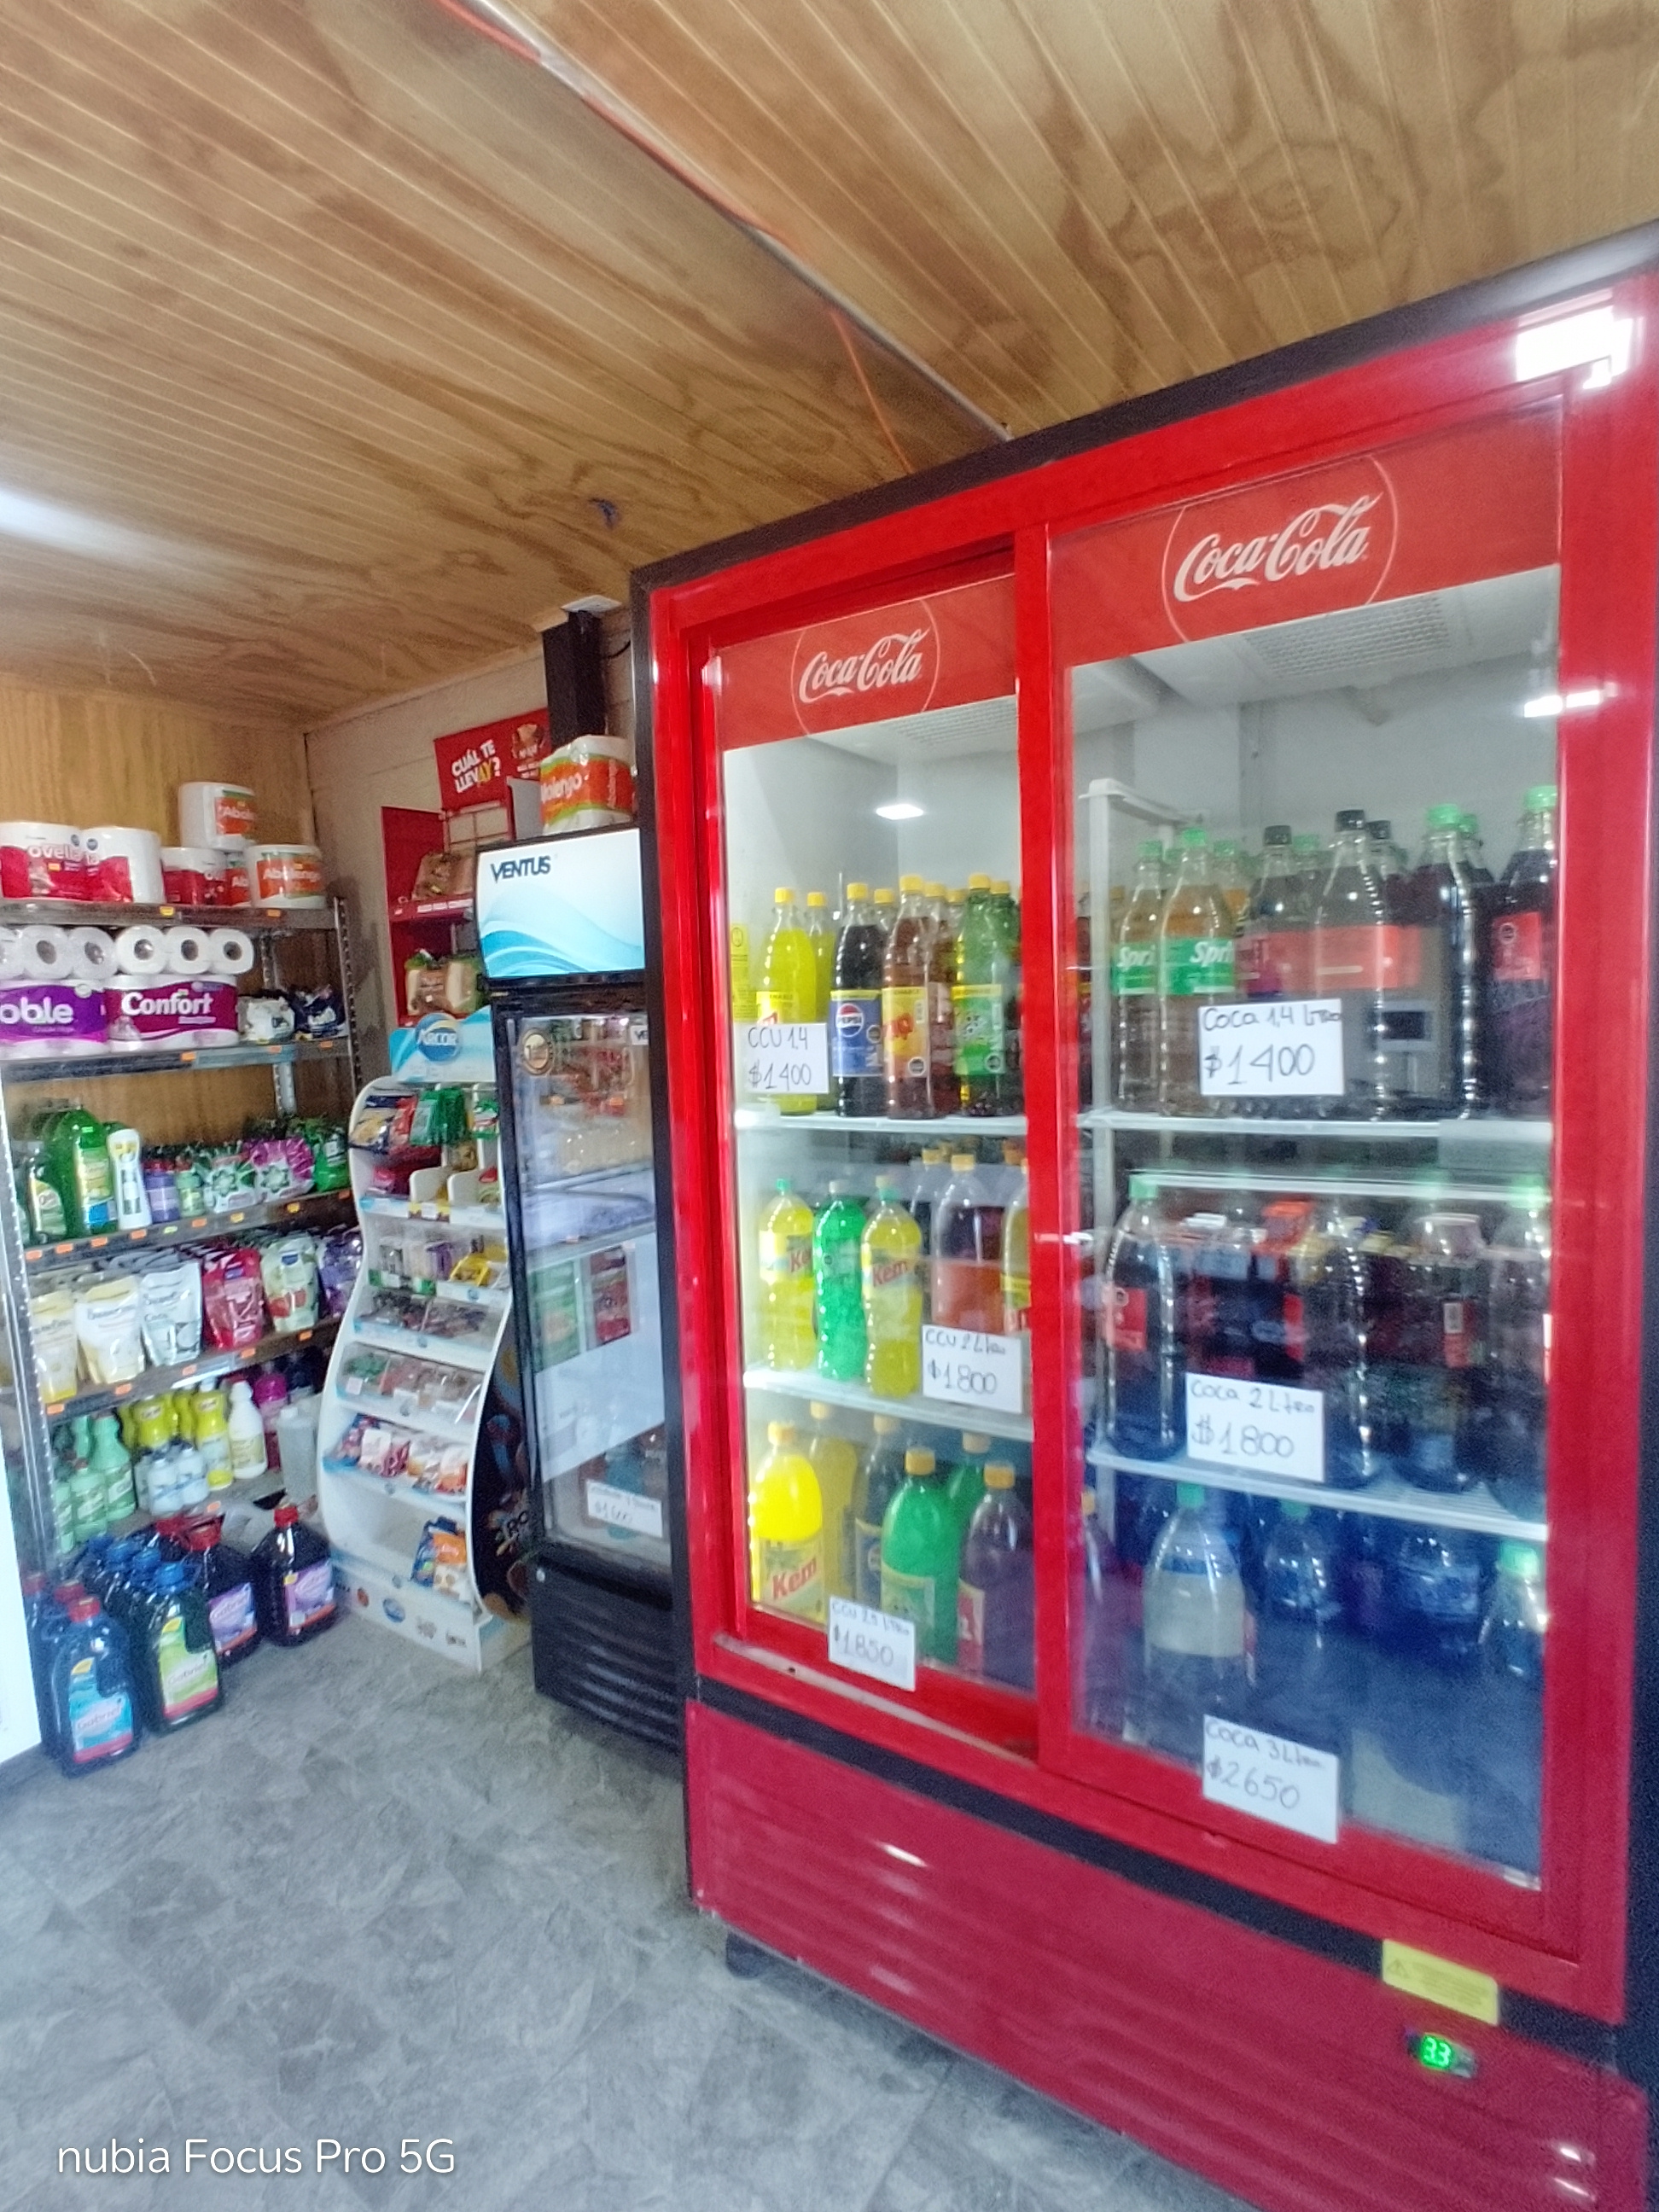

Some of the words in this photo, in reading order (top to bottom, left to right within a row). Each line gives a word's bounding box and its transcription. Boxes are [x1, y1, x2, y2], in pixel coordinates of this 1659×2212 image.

[480, 739, 496, 758] TE
[490, 855, 551, 883] VENTUS
[120, 991, 214, 1016] Confort
[748, 1027, 782, 1049] CCU
[789, 1249, 812, 1273] Ke
[1190, 1413, 1295, 1458] $1800
